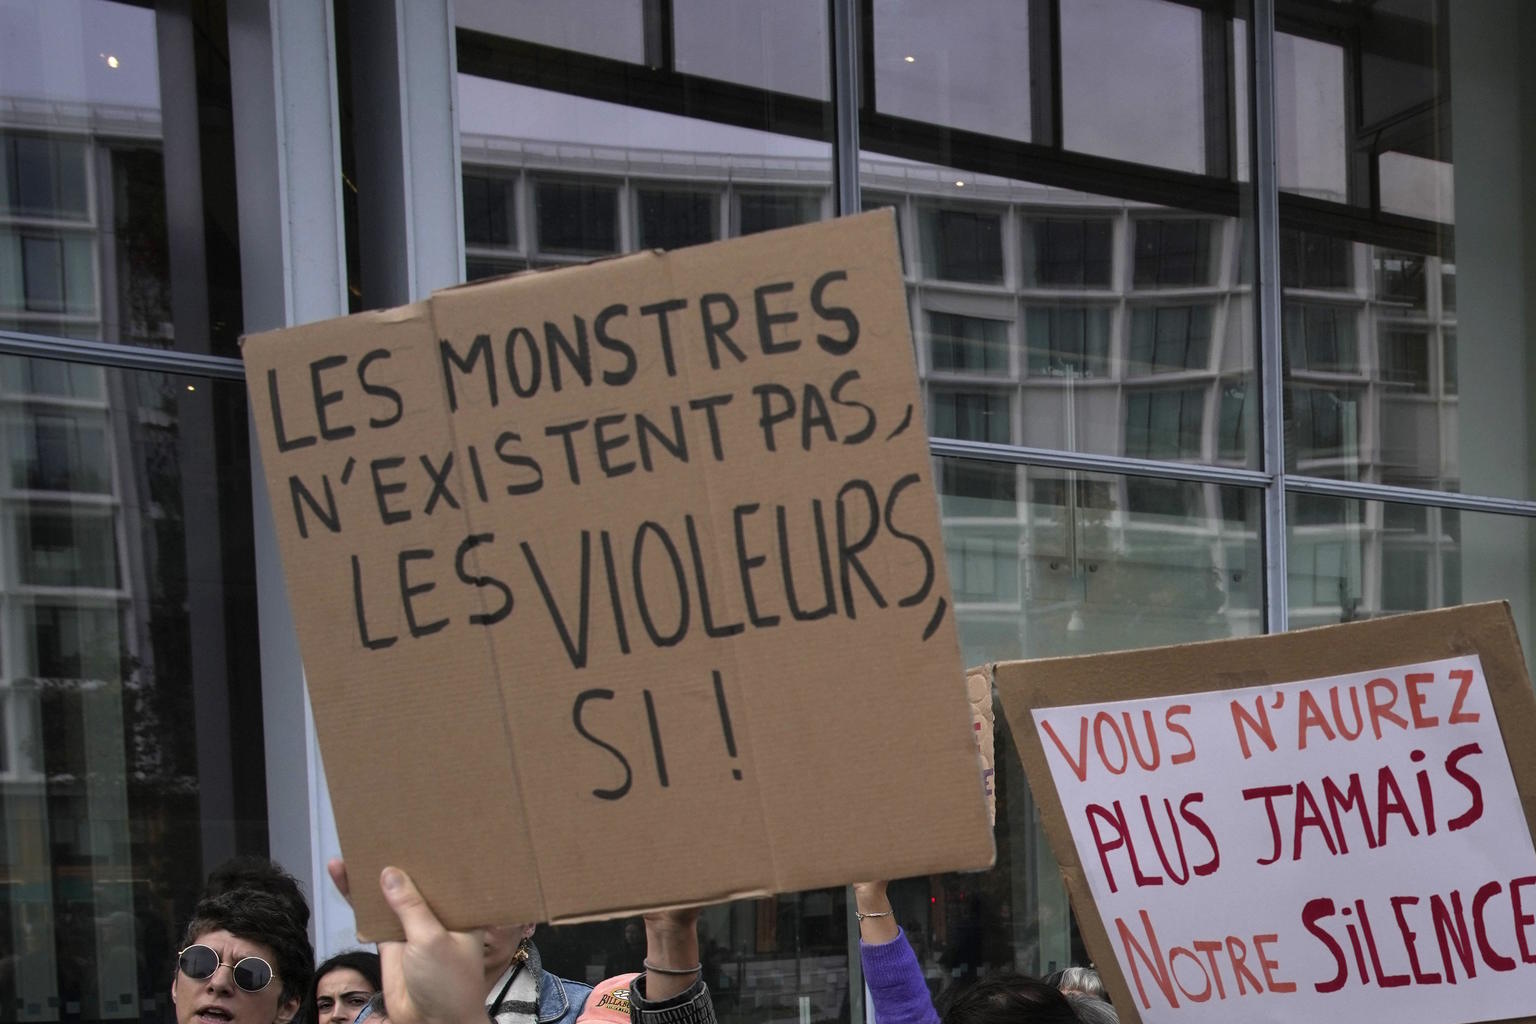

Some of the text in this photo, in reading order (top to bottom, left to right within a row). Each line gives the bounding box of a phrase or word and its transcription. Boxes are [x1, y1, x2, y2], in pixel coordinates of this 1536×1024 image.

[268, 270, 859, 452] LES MONSTRES
[289, 370, 913, 538] N'EXISTENT PAS,
[352, 473, 948, 669] LES VIOLEURS,
[1041, 669, 1480, 782] VOUS N'AUREZ
[1085, 793, 1220, 894] PLUS
